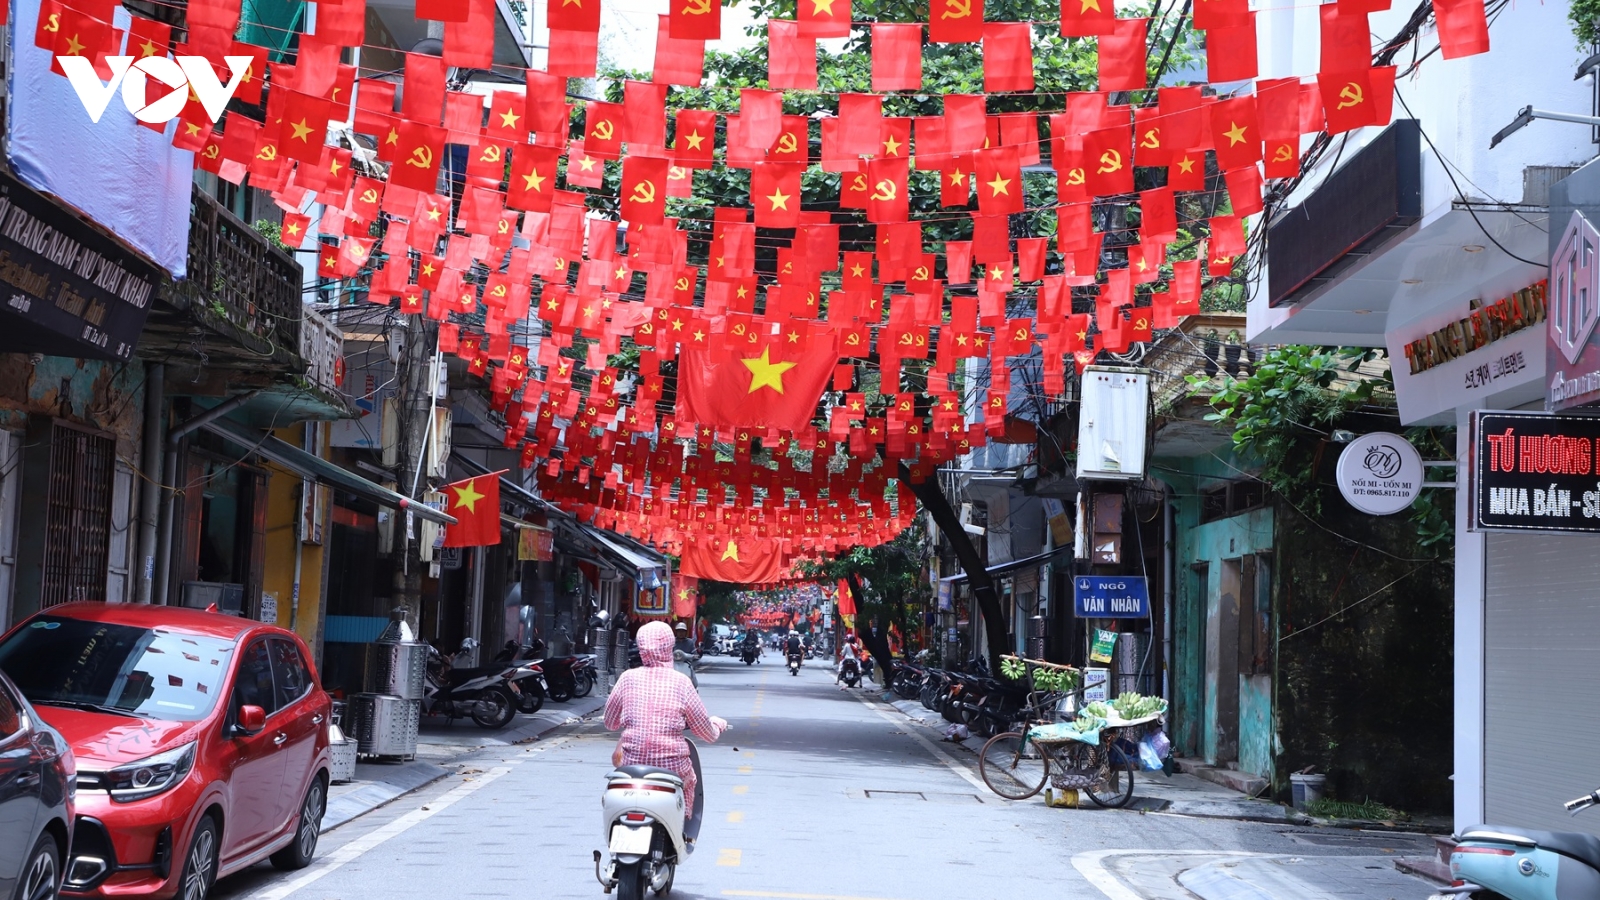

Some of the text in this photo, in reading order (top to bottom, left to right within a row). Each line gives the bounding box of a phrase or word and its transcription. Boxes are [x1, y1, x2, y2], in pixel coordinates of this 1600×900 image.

[5, 204, 53, 255] TRANG
[1404, 321, 1467, 376] TRANG
[1487, 428, 1515, 472] TÚ
[1519, 434, 1592, 475] HƯƠNG
[1352, 478, 1366, 487] NỐI
[1368, 480, 1378, 488] MI
[1383, 479, 1400, 488] UỐN
[1489, 487, 1530, 515] MUA
[1533, 483, 1571, 517] BÁN
[1098, 581, 1127, 590] NGÕ
[1083, 595, 1140, 612] VĂN NHÂN
